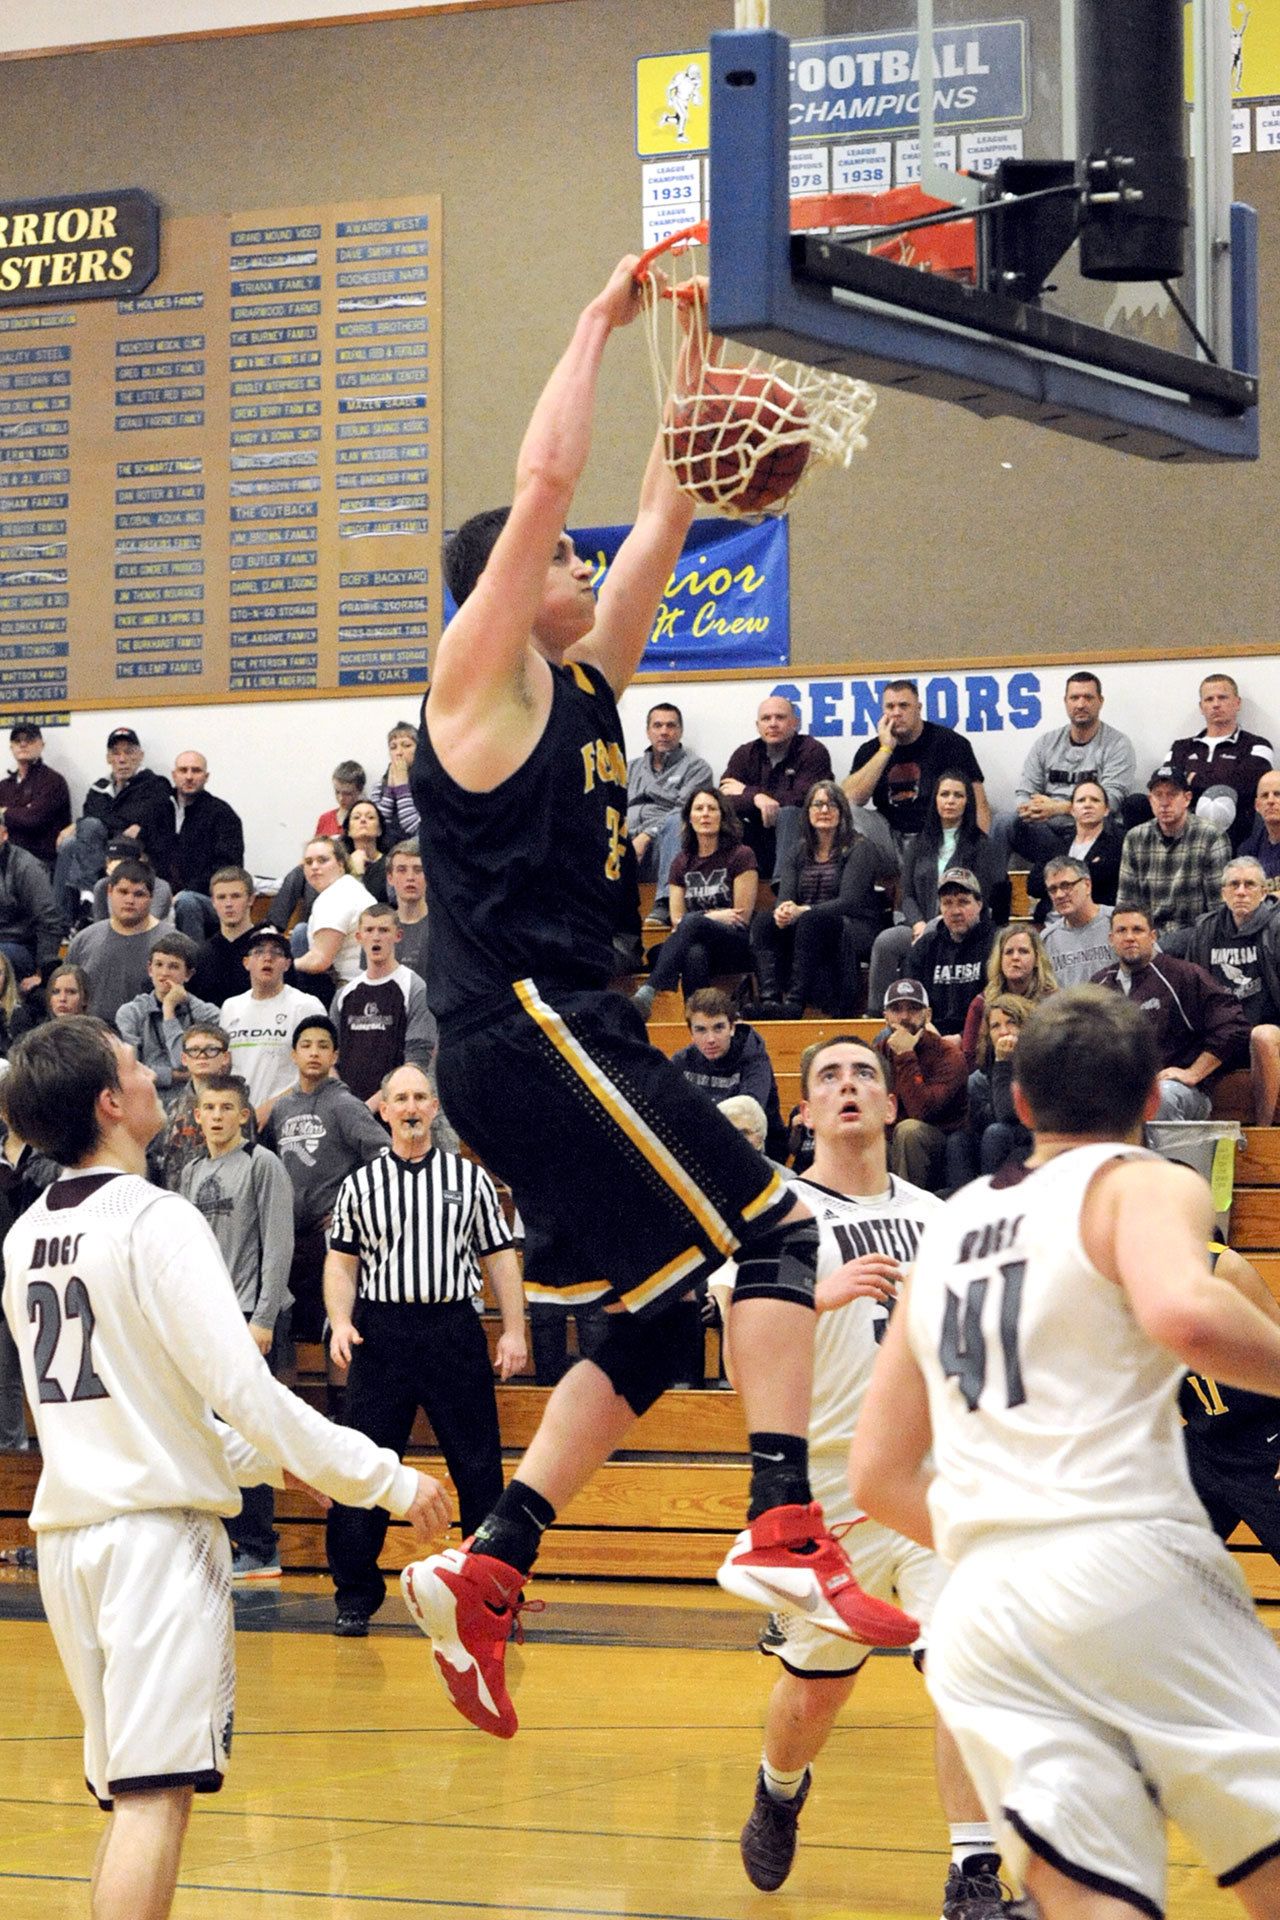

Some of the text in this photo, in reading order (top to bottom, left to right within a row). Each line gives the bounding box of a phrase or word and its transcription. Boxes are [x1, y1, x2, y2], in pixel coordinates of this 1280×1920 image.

[788, 42, 990, 92] OOTBALL
[977, 135, 1008, 144] LEAGUE
[847, 147, 876, 156] LEAGUE
[967, 144, 1018, 154] CHAMPIONS
[838, 156, 886, 167] CHAMPIONS
[656, 166, 685, 174] LEAGUE
[843, 169, 884, 183] 1938
[648, 174, 695, 184] CHAMPIONS
[790, 174, 822, 187] 978
[653, 186, 692, 200] 1933
[657, 208, 686, 217] LEAGUE
[346, 219, 420, 235] AWARDS WEST
[649, 217, 696, 227] CHAMPIONS
[234, 227, 320, 245] GRAND MOUND VIDEO
[395, 243, 426, 256] FAMILY
[340, 268, 425, 286] ROCHESTER NAPA
[239, 279, 314, 294] TRIANA FAMILY
[118, 300, 134, 312] THE
[234, 303, 319, 320] BRIARWOOD FARMS
[377, 319, 426, 334] BROTHERS
[231, 333, 248, 345] THE
[286, 328, 316, 340] FAMILY
[36, 348, 62, 361] STEEL
[175, 363, 202, 375] FAMILY
[180, 413, 202, 425] FAMILY
[36, 447, 68, 459] FAMILY
[118, 465, 132, 476] THE
[176, 487, 202, 499] FAMILY
[32, 497, 64, 509] FAMILY
[236, 504, 314, 519] THE OUTBACK
[118, 515, 152, 527] GLOBAL
[157, 513, 182, 525] AQUA
[38, 522, 66, 534] FAMILY
[284, 529, 316, 541] FAMILY
[232, 553, 316, 568] ED BUTLER FAMILY
[341, 571, 426, 586] BOB'S BACKYARD
[278, 605, 316, 618] STORAGE
[40, 620, 66, 632] FAMILY
[692, 602, 770, 638] Crew
[232, 630, 316, 645] THE FAMILY
[118, 640, 131, 652] THE
[118, 665, 134, 677] THE
[170, 661, 202, 674] FAMILY
[232, 659, 246, 670] THE
[290, 656, 316, 667] FAMILY
[40, 669, 66, 680] FAMILY
[357, 669, 409, 682] 40 OAKS
[23, 688, 66, 700] SOCIETY
[770, 673, 1042, 737] SENORS
[229, 1029, 288, 1040] ORDAN
[27, 1276, 111, 1404] 22
[938, 1260, 1028, 1414] 41
